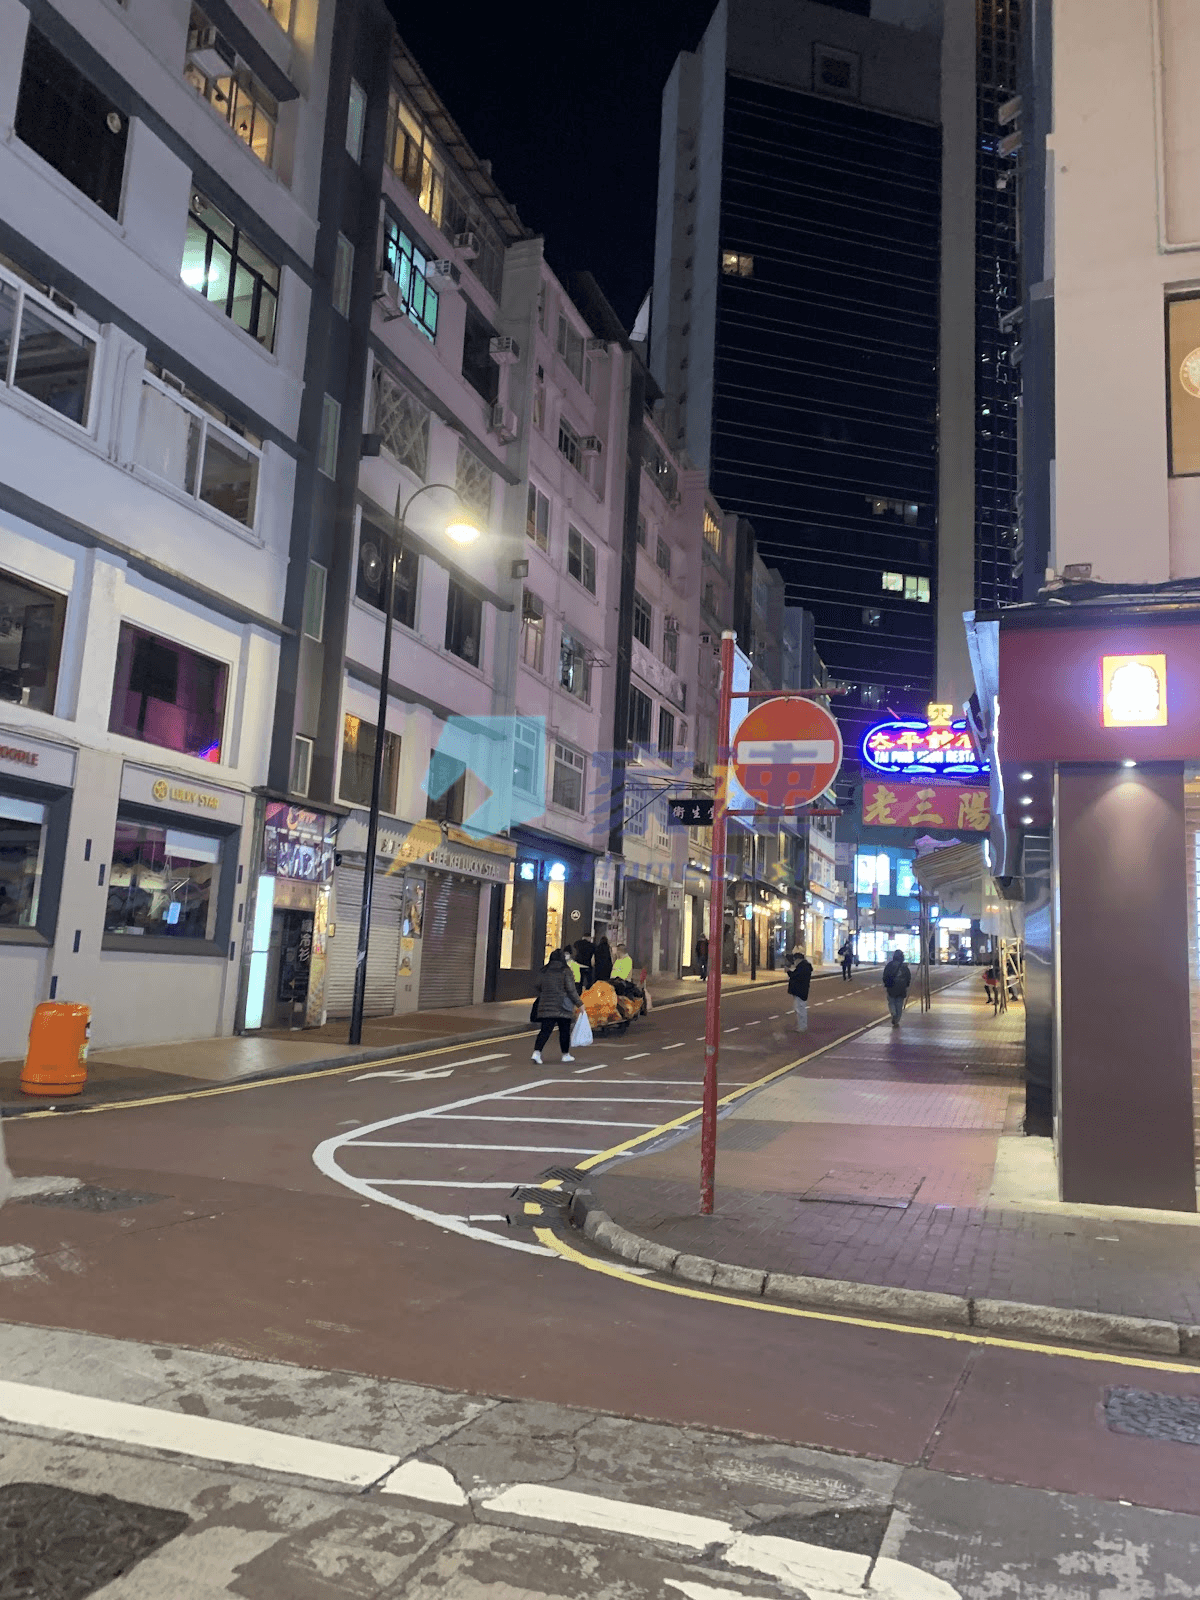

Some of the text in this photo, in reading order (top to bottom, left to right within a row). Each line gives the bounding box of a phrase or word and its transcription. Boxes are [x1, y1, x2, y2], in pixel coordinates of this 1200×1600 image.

[172, 788, 220, 809] LUCKY STAR
[863, 785, 990, 830] 老三陽
[462, 858, 484, 873] LUCKY
